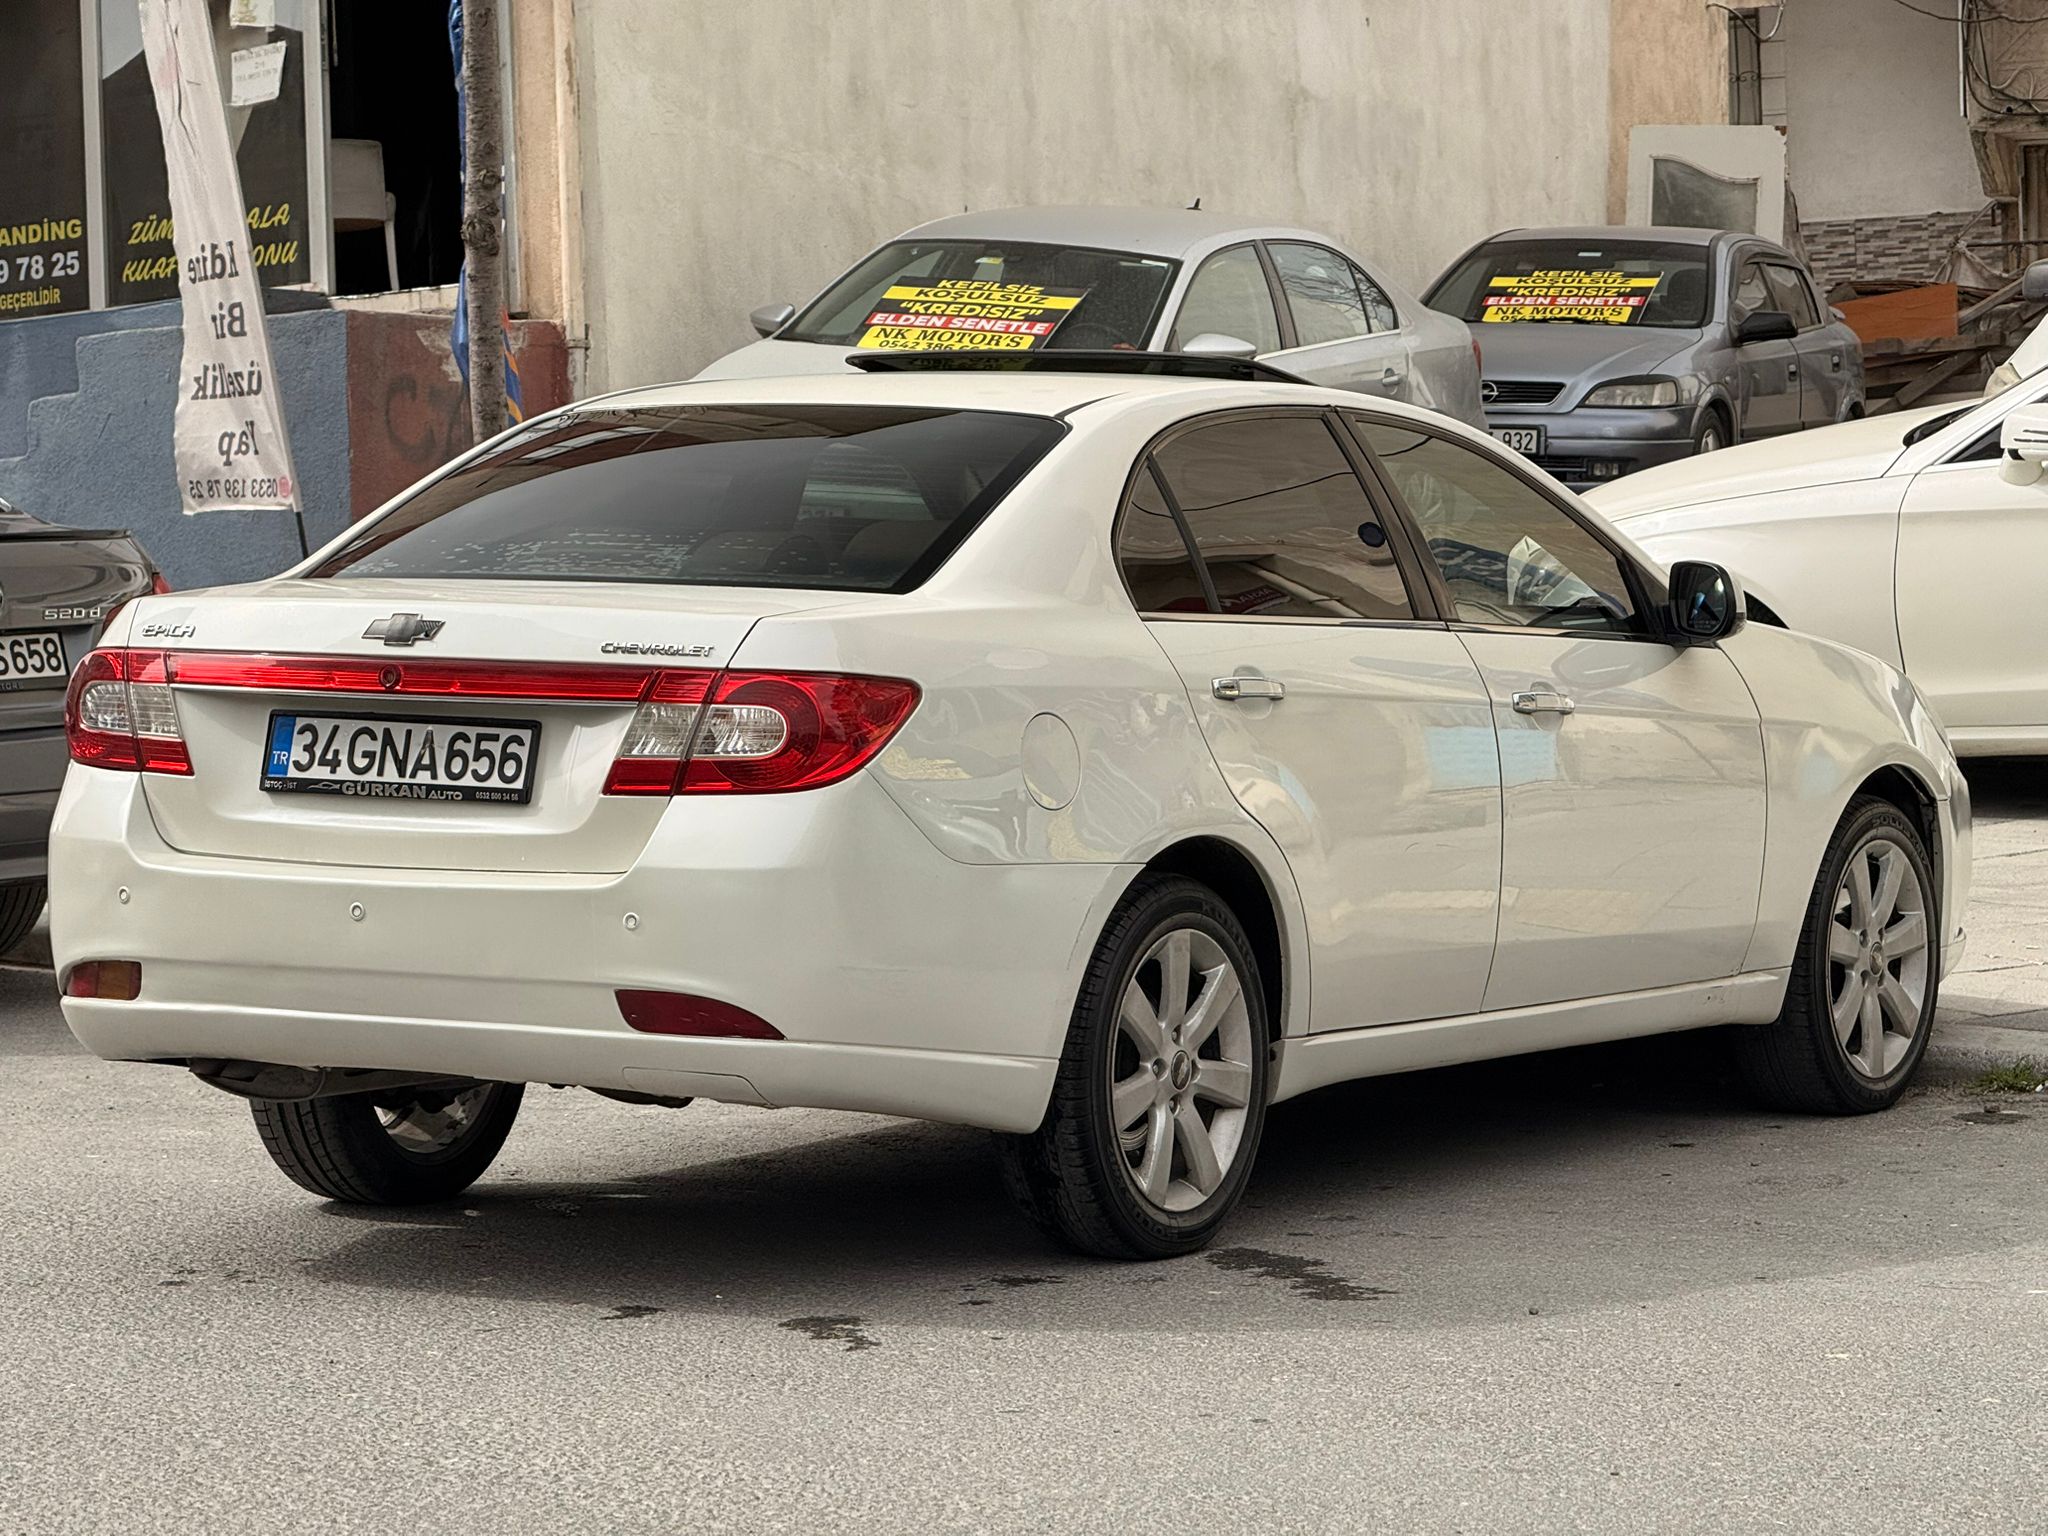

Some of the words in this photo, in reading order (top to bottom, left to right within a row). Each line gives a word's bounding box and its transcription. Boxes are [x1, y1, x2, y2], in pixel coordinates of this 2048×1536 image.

[128, 214, 174, 245] ZÜM
[247, 203, 290, 229] ALA
[253, 241, 298, 267] ONU
[16, 254, 44, 281] 78
[51, 250, 80, 277] 25
[0, 286, 61, 312] GEÇERLİDİR
[915, 288, 1050, 305] KOŞULSUZ
[1487, 296, 1551, 305] ELDEN
[1556, 297, 1640, 306] SENETLE
[1494, 307, 1526, 315] NK
[871, 312, 946, 328] ELDEN
[948, 317, 1050, 335] SENETLE
[874, 328, 912, 340] NK
[879, 339, 920, 349] 0542
[1502, 431, 1534, 451] 932
[142, 623, 196, 638] EPICA
[600, 640, 714, 657] CHEVROLET
[272, 750, 289, 765] TR
[341, 780, 426, 799] GÜRKAN
[428, 789, 463, 800] AUTO
